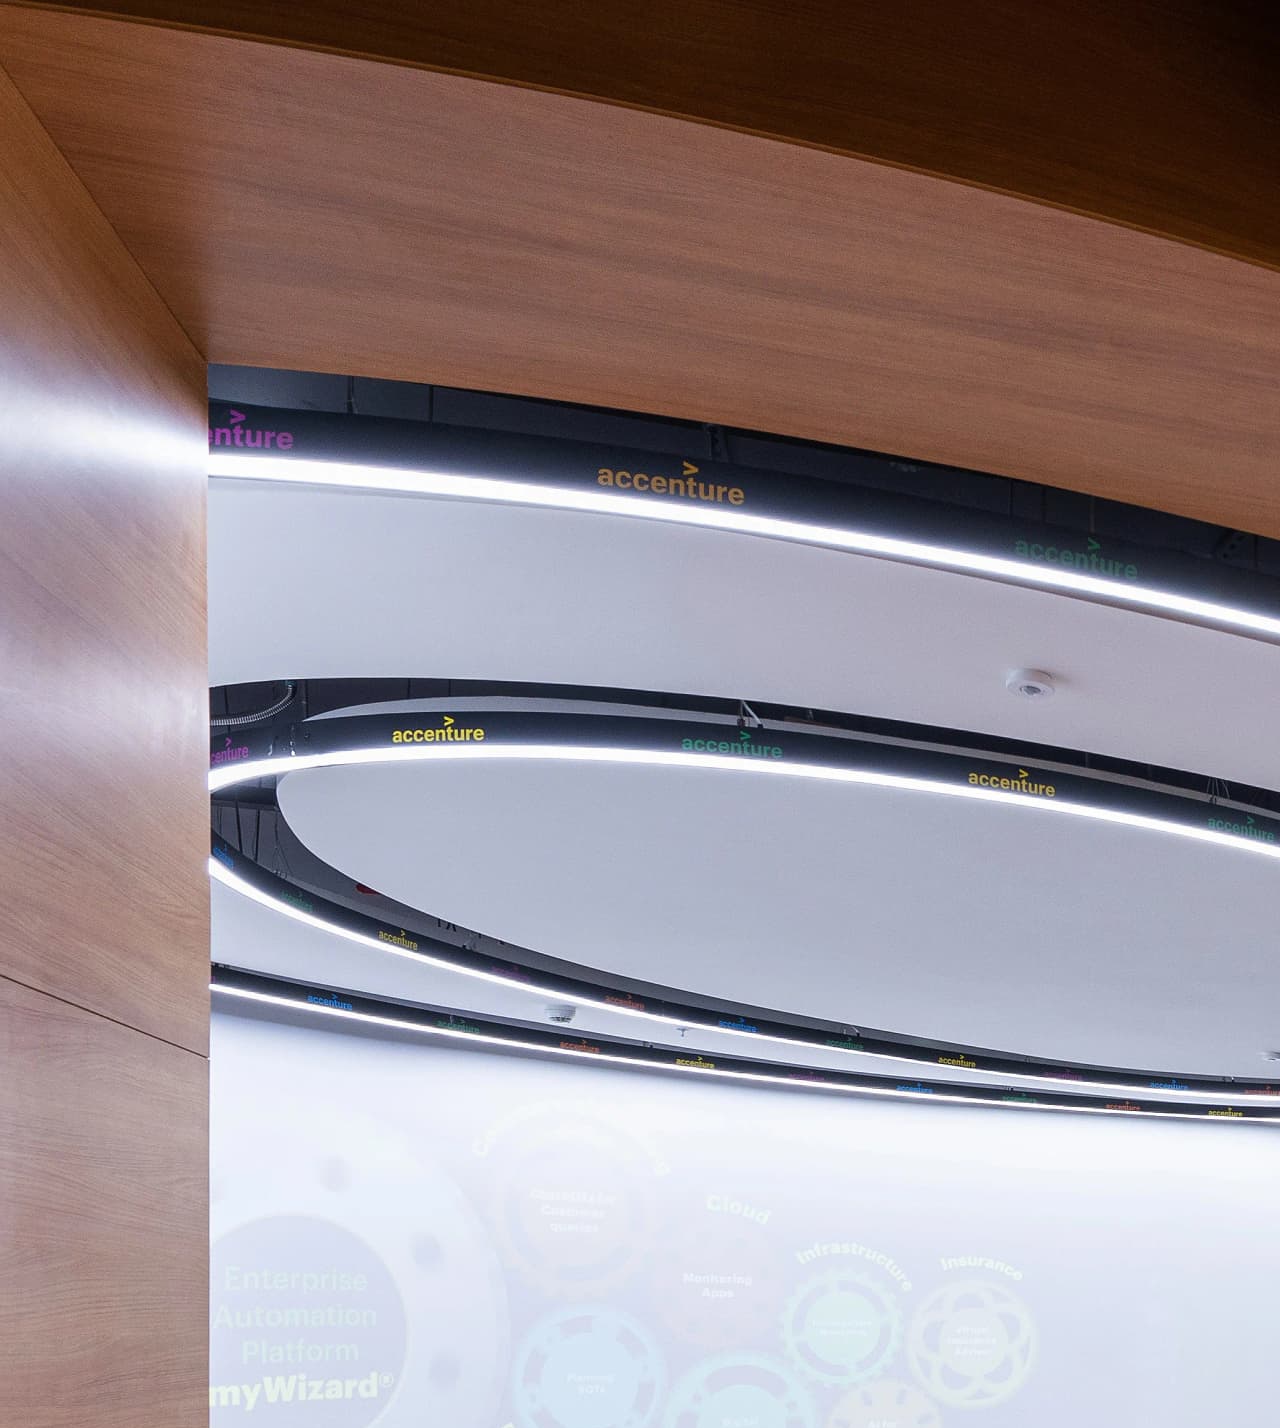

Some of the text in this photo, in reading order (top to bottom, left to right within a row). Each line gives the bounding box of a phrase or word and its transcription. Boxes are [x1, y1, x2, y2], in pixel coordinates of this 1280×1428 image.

[208, 425, 294, 450] nture
[597, 465, 745, 506] accenture
[1015, 537, 1138, 581] accenture
[392, 725, 485, 744] accenture
[681, 734, 783, 760] accenture
[968, 769, 1056, 798] accenture
[1208, 815, 1275, 844] accenture
[378, 929, 418, 951] accenture
[307, 995, 353, 1011] accenture
[719, 1020, 758, 1033] accenture
[675, 1058, 715, 1070] accenture
[938, 1056, 976, 1068] accenture
[706, 1192, 773, 1225] Cloud
[794, 1240, 914, 1293] Infrastructure
[939, 1255, 1024, 1281] Insurance
[223, 1265, 369, 1295] Enterprise
[212, 1303, 377, 1329] Automation
[240, 1337, 360, 1366] Platform
